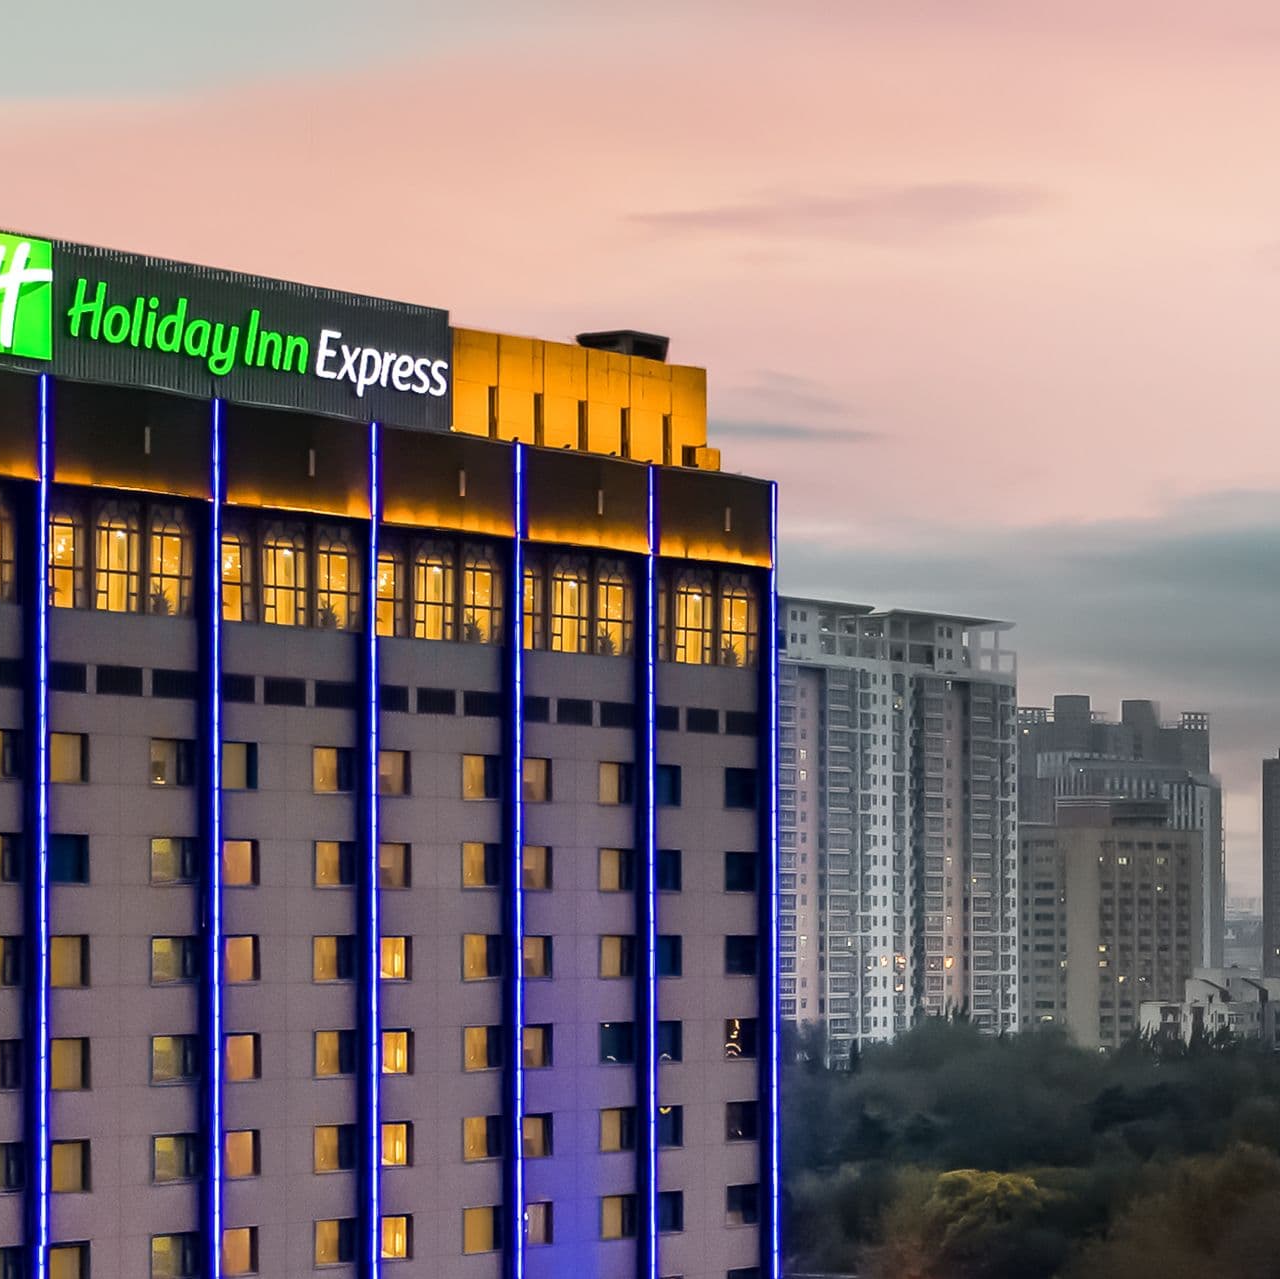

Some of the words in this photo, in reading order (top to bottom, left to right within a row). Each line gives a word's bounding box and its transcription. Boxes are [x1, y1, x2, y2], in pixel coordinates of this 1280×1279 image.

[67, 277, 240, 376] Holiday
[244, 309, 309, 375] Inn
[315, 329, 449, 398] Express
